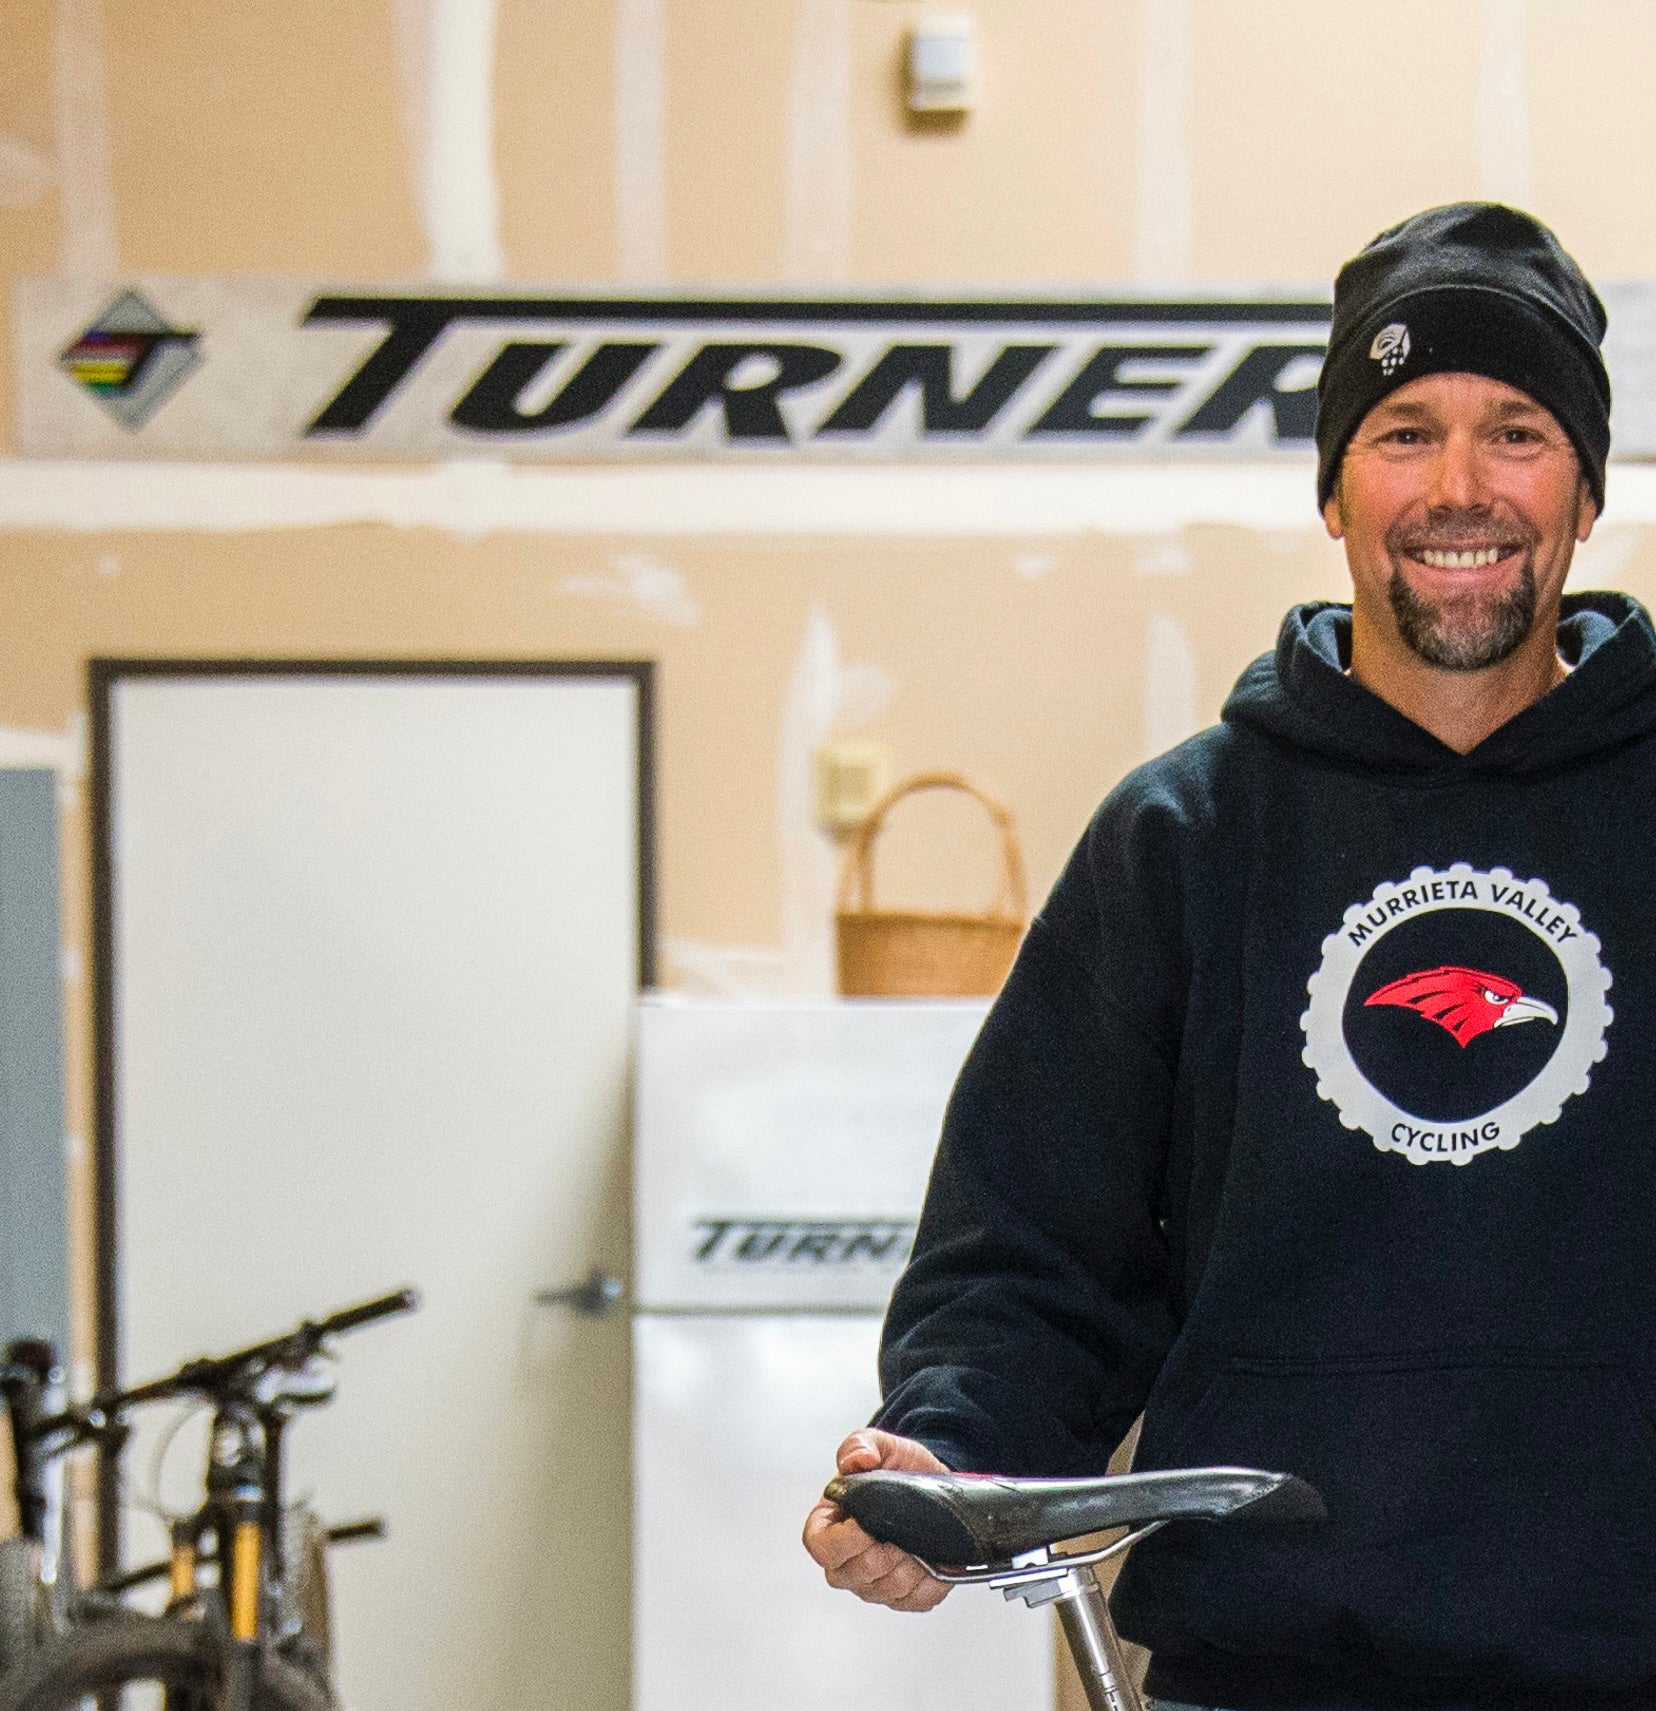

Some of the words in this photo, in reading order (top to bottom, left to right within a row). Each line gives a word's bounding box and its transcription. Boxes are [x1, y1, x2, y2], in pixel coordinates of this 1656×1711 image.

[1347, 880, 1479, 948] MURRIETA
[1491, 883, 1578, 945] VALLEY
[1391, 1121, 1501, 1152] CYCLING
[694, 1214, 918, 1262] TURN
